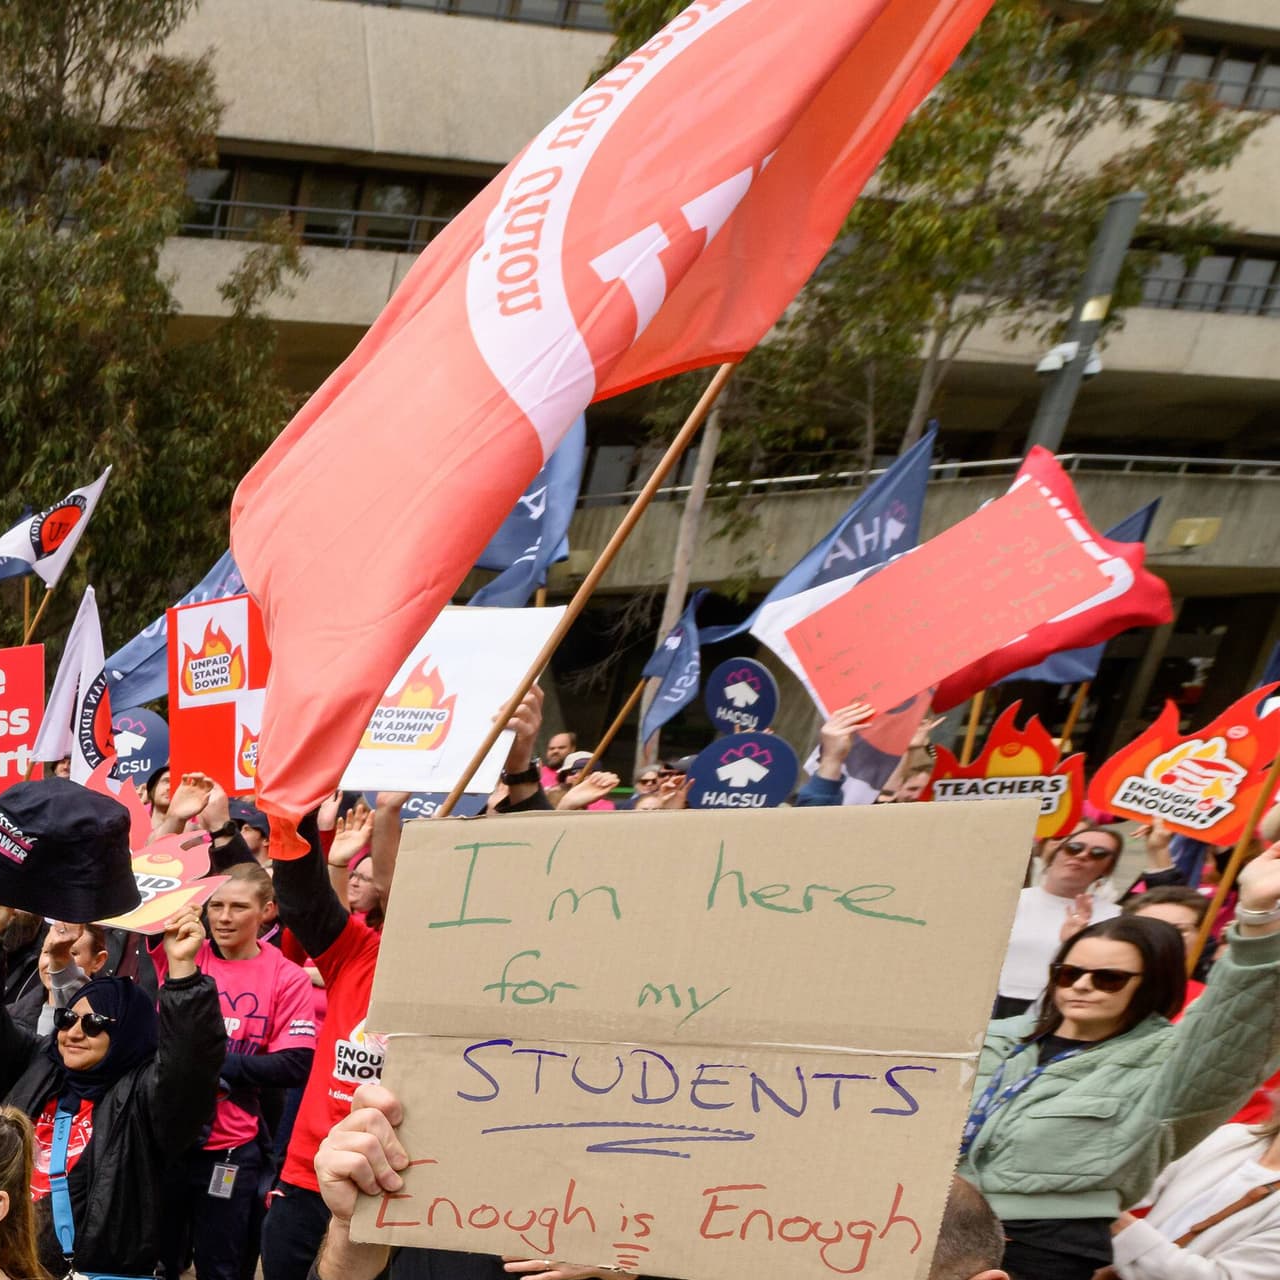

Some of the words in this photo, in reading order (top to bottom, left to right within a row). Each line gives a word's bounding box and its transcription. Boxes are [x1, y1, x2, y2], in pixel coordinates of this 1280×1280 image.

[190, 655, 230, 671] UNPAID
[194, 666, 228, 681] STAND
[195, 675, 229, 690] DOWN
[375, 708, 446, 722] ROWNING
[385, 720, 434, 733] ADMIN
[373, 732, 417, 744] WORK
[938, 778, 1063, 797] TEACHERS
[1127, 780, 1197, 810] ENOUGH
[700, 790, 768, 808] HACSU
[1120, 791, 1228, 825] ENOUGH!
[429, 830, 622, 929] I'm
[706, 840, 927, 926] here
[483, 950, 578, 1005] for
[638, 984, 731, 1028] my
[456, 1037, 937, 1118] STUDENTS
[374, 1158, 597, 1255] Enough
[619, 1200, 652, 1239] is
[700, 1182, 923, 1275] Enough
